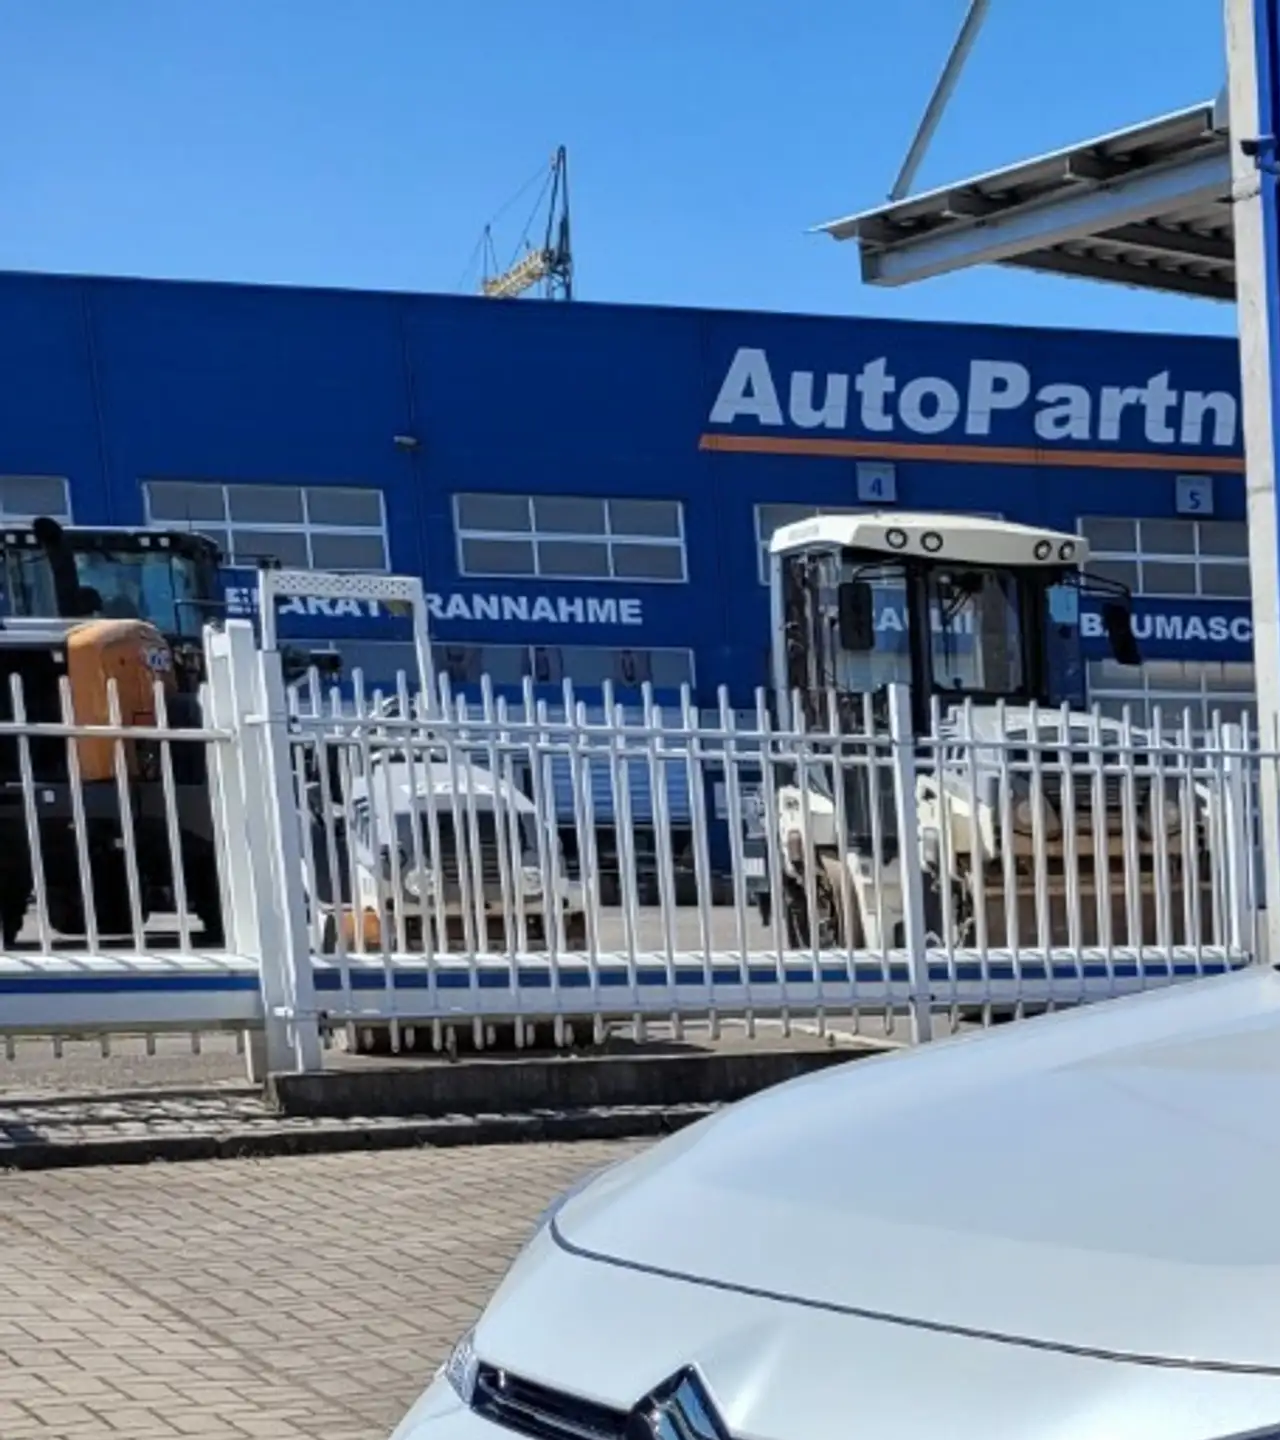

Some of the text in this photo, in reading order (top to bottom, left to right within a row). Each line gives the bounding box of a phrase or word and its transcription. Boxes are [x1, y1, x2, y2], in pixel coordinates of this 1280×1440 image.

[708, 346, 1236, 446] AutoPartn
[870, 477, 883, 497] 4
[1188, 489, 1202, 510] 5
[1080, 612, 1252, 643] BUMASC
